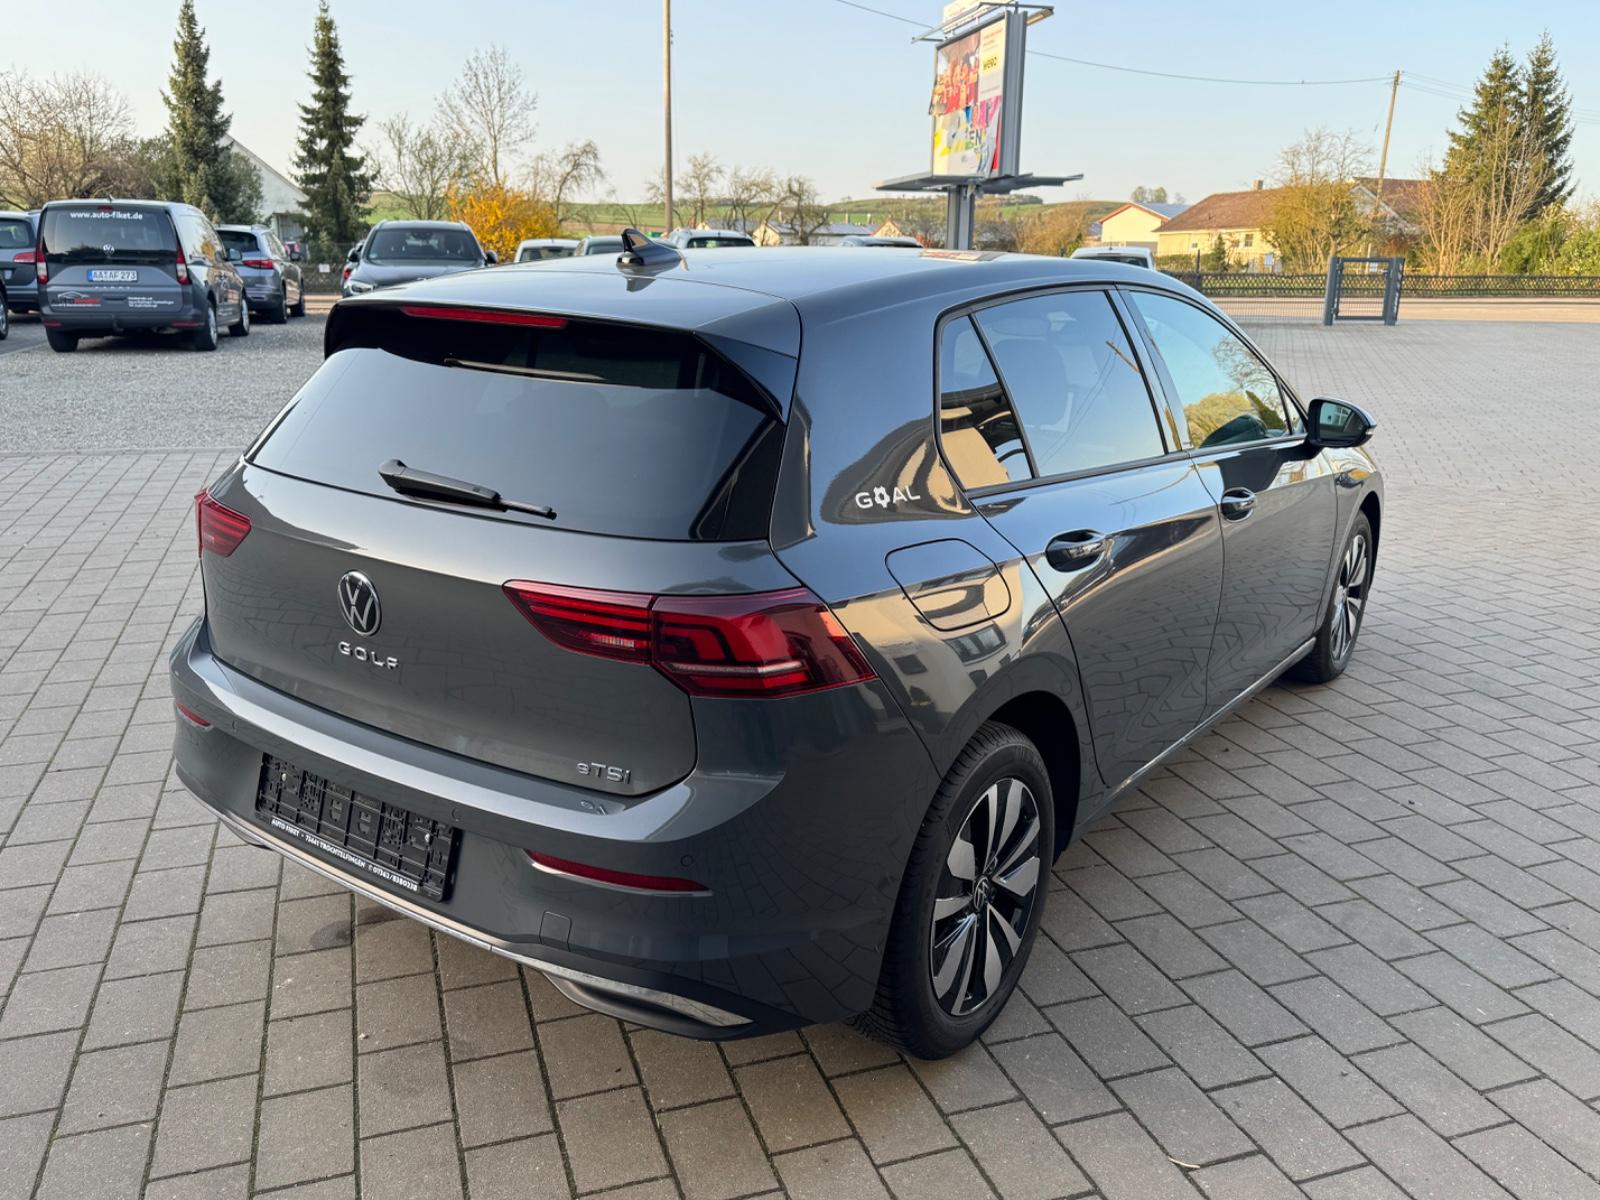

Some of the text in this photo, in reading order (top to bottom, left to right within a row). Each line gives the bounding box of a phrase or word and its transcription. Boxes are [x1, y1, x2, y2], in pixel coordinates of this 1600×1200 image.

[70, 211, 143, 220] www.auto-fiket.de
[120, 271, 136, 280] 273
[855, 485, 921, 509] GOAL
[338, 641, 399, 670] GOLF
